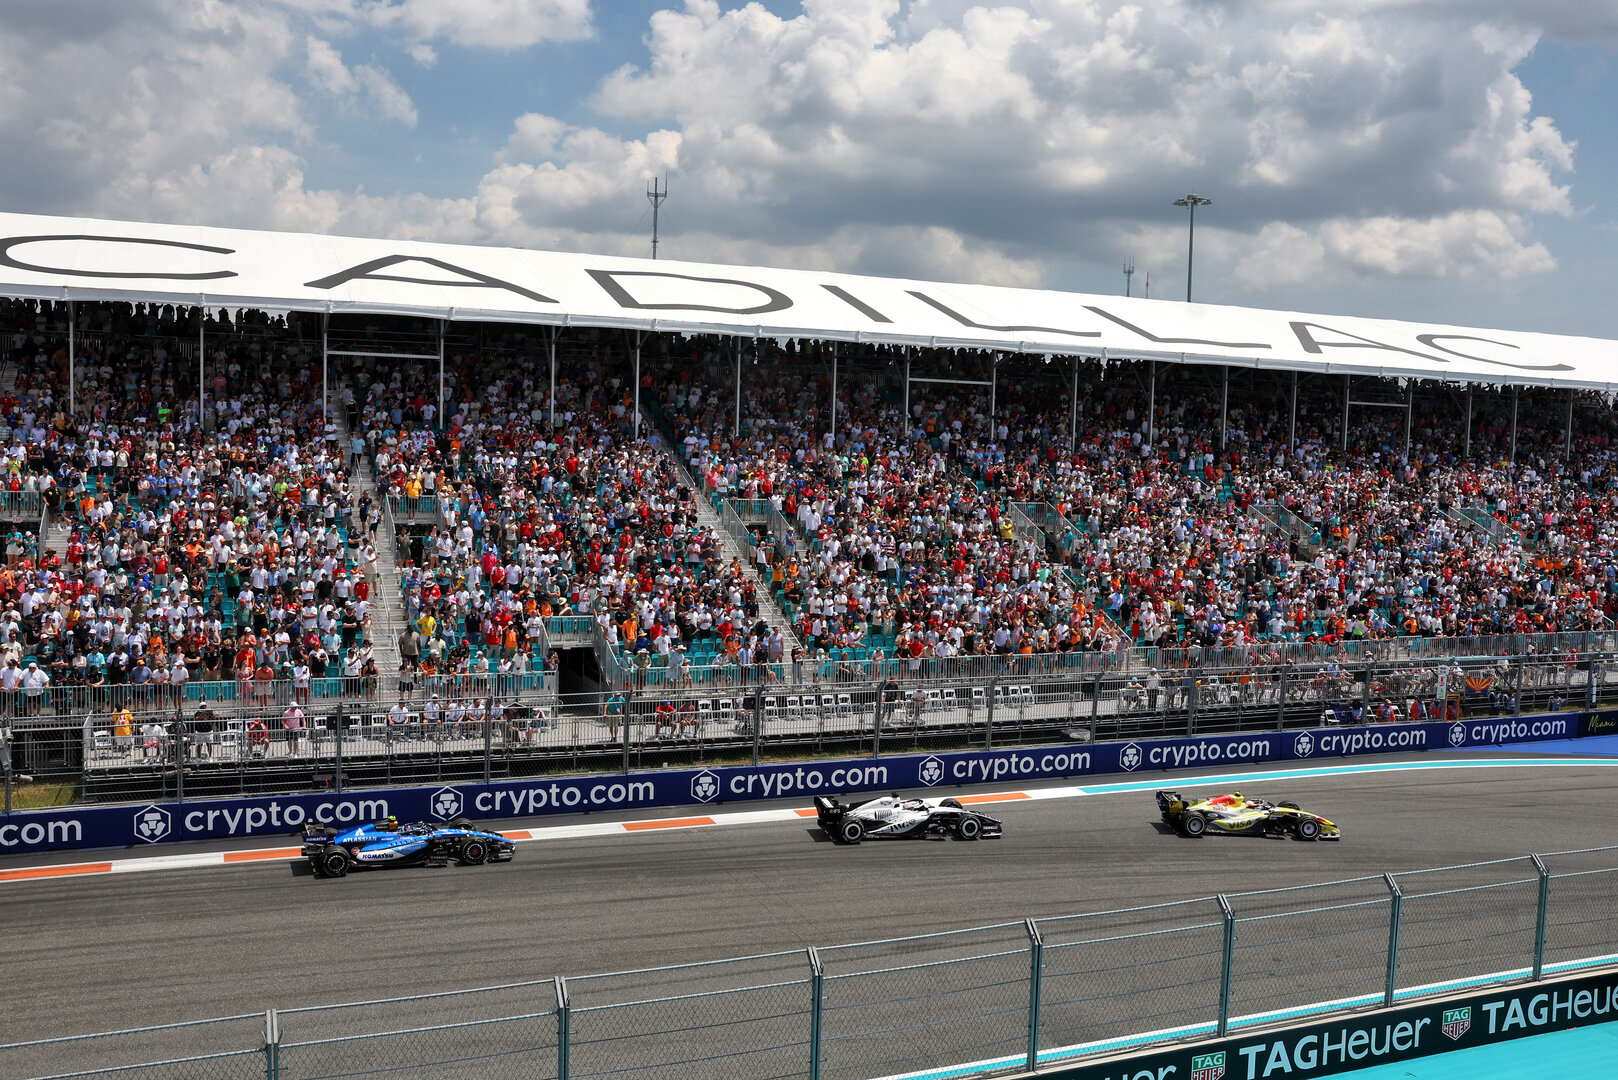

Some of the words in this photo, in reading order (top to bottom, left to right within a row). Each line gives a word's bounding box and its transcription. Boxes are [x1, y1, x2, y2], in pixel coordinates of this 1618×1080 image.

[0, 235, 1577, 371] CADILLAC
[1320, 730, 1426, 754] crypto.com
[1471, 720, 1566, 743] crypto.com
[1149, 741, 1270, 766] crypto.com
[952, 753, 1091, 781] crypto.com
[730, 767, 888, 797] crypto.com
[475, 782, 655, 814] crypto.com
[184, 799, 389, 834] crypto.com
[1229, 820, 1252, 829] VISA
[1445, 1009, 1469, 1022] TAG
[1443, 1020, 1469, 1038] HEUER
[1194, 1054, 1223, 1069] TAG
